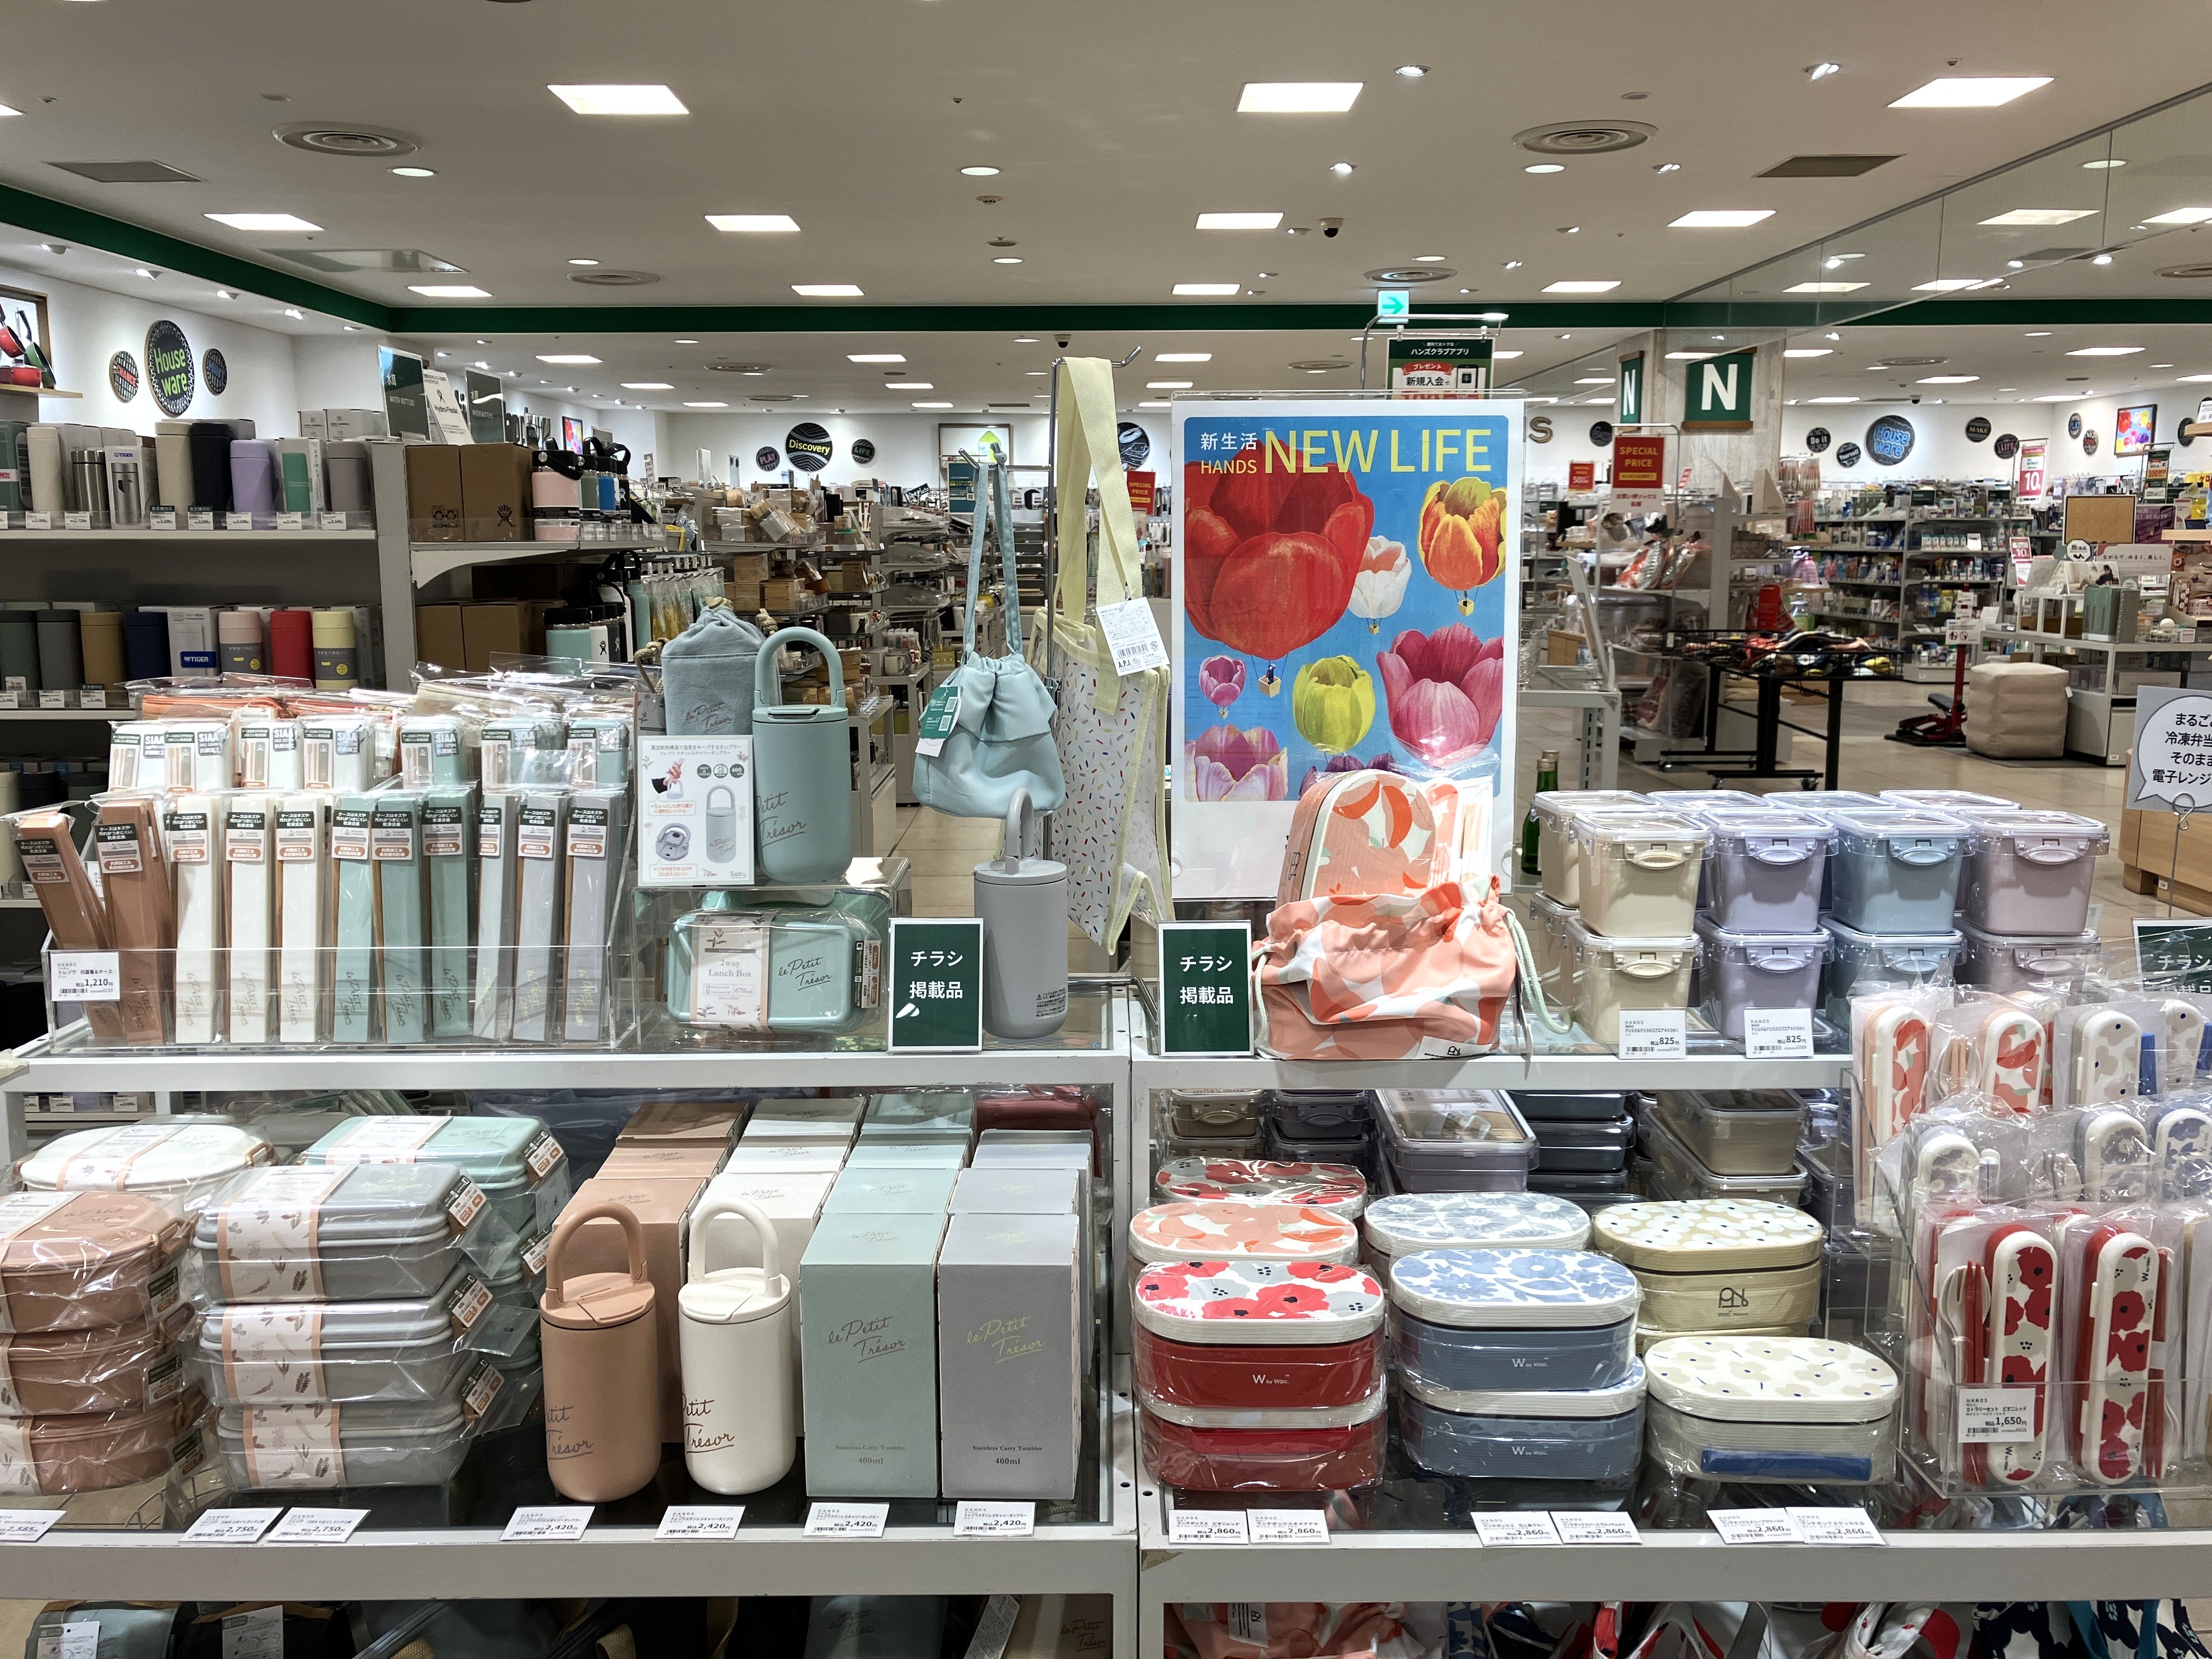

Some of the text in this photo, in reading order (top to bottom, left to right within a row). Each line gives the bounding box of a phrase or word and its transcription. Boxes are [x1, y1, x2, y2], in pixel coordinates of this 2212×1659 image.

[154, 347, 186, 374] House
[161, 373, 188, 397] ware
[1406, 376, 1450, 386] 新規入会で
[1701, 364, 1738, 410] N
[1623, 369, 1635, 416] N
[1200, 432, 1257, 450] 新生活
[1875, 424, 1909, 445] House
[789, 439, 831, 455] Discovery
[854, 446, 871, 456] LIFE
[1265, 430, 1491, 473] NEW LIFE
[1620, 447, 1658, 455] SPECIAL
[1875, 441, 1903, 457] ware
[759, 454, 776, 465] PLAY
[1200, 459, 1257, 474] HANDS
[1625, 459, 1653, 467] PRICE
[145, 736, 164, 744] SIAA
[199, 733, 219, 742] SIAA
[274, 729, 294, 738] SIAA
[337, 732, 357, 741] SIAA
[436, 733, 456, 743] SIAA
[2165, 731, 2212, 747] 冷凍弁当
[759, 816, 806, 841] Trésor
[720, 959, 741, 968] 2way
[911, 950, 963, 966] チラシ
[1180, 956, 1232, 972] チラシ
[2158, 955, 2210, 970] チラシ
[778, 957, 824, 977] le Petit
[795, 971, 832, 986] Trésor
[910, 981, 963, 998] 掲載品
[1180, 986, 1233, 1004] 掲載品
[2141, 1272, 2149, 1282] W
[828, 1316, 894, 1344] le Petit
[967, 1316, 1031, 1344] le Petit
[854, 1335, 906, 1357] Trésor
[992, 1335, 1044, 1357] Trésor
[1512, 1358, 1525, 1367] W
[1252, 1374, 1266, 1384] W
[547, 1430, 594, 1454] Trésor
[684, 1423, 735, 1448] Trésor
[1512, 1446, 1525, 1455] W
[2005, 1446, 2013, 1455] W
